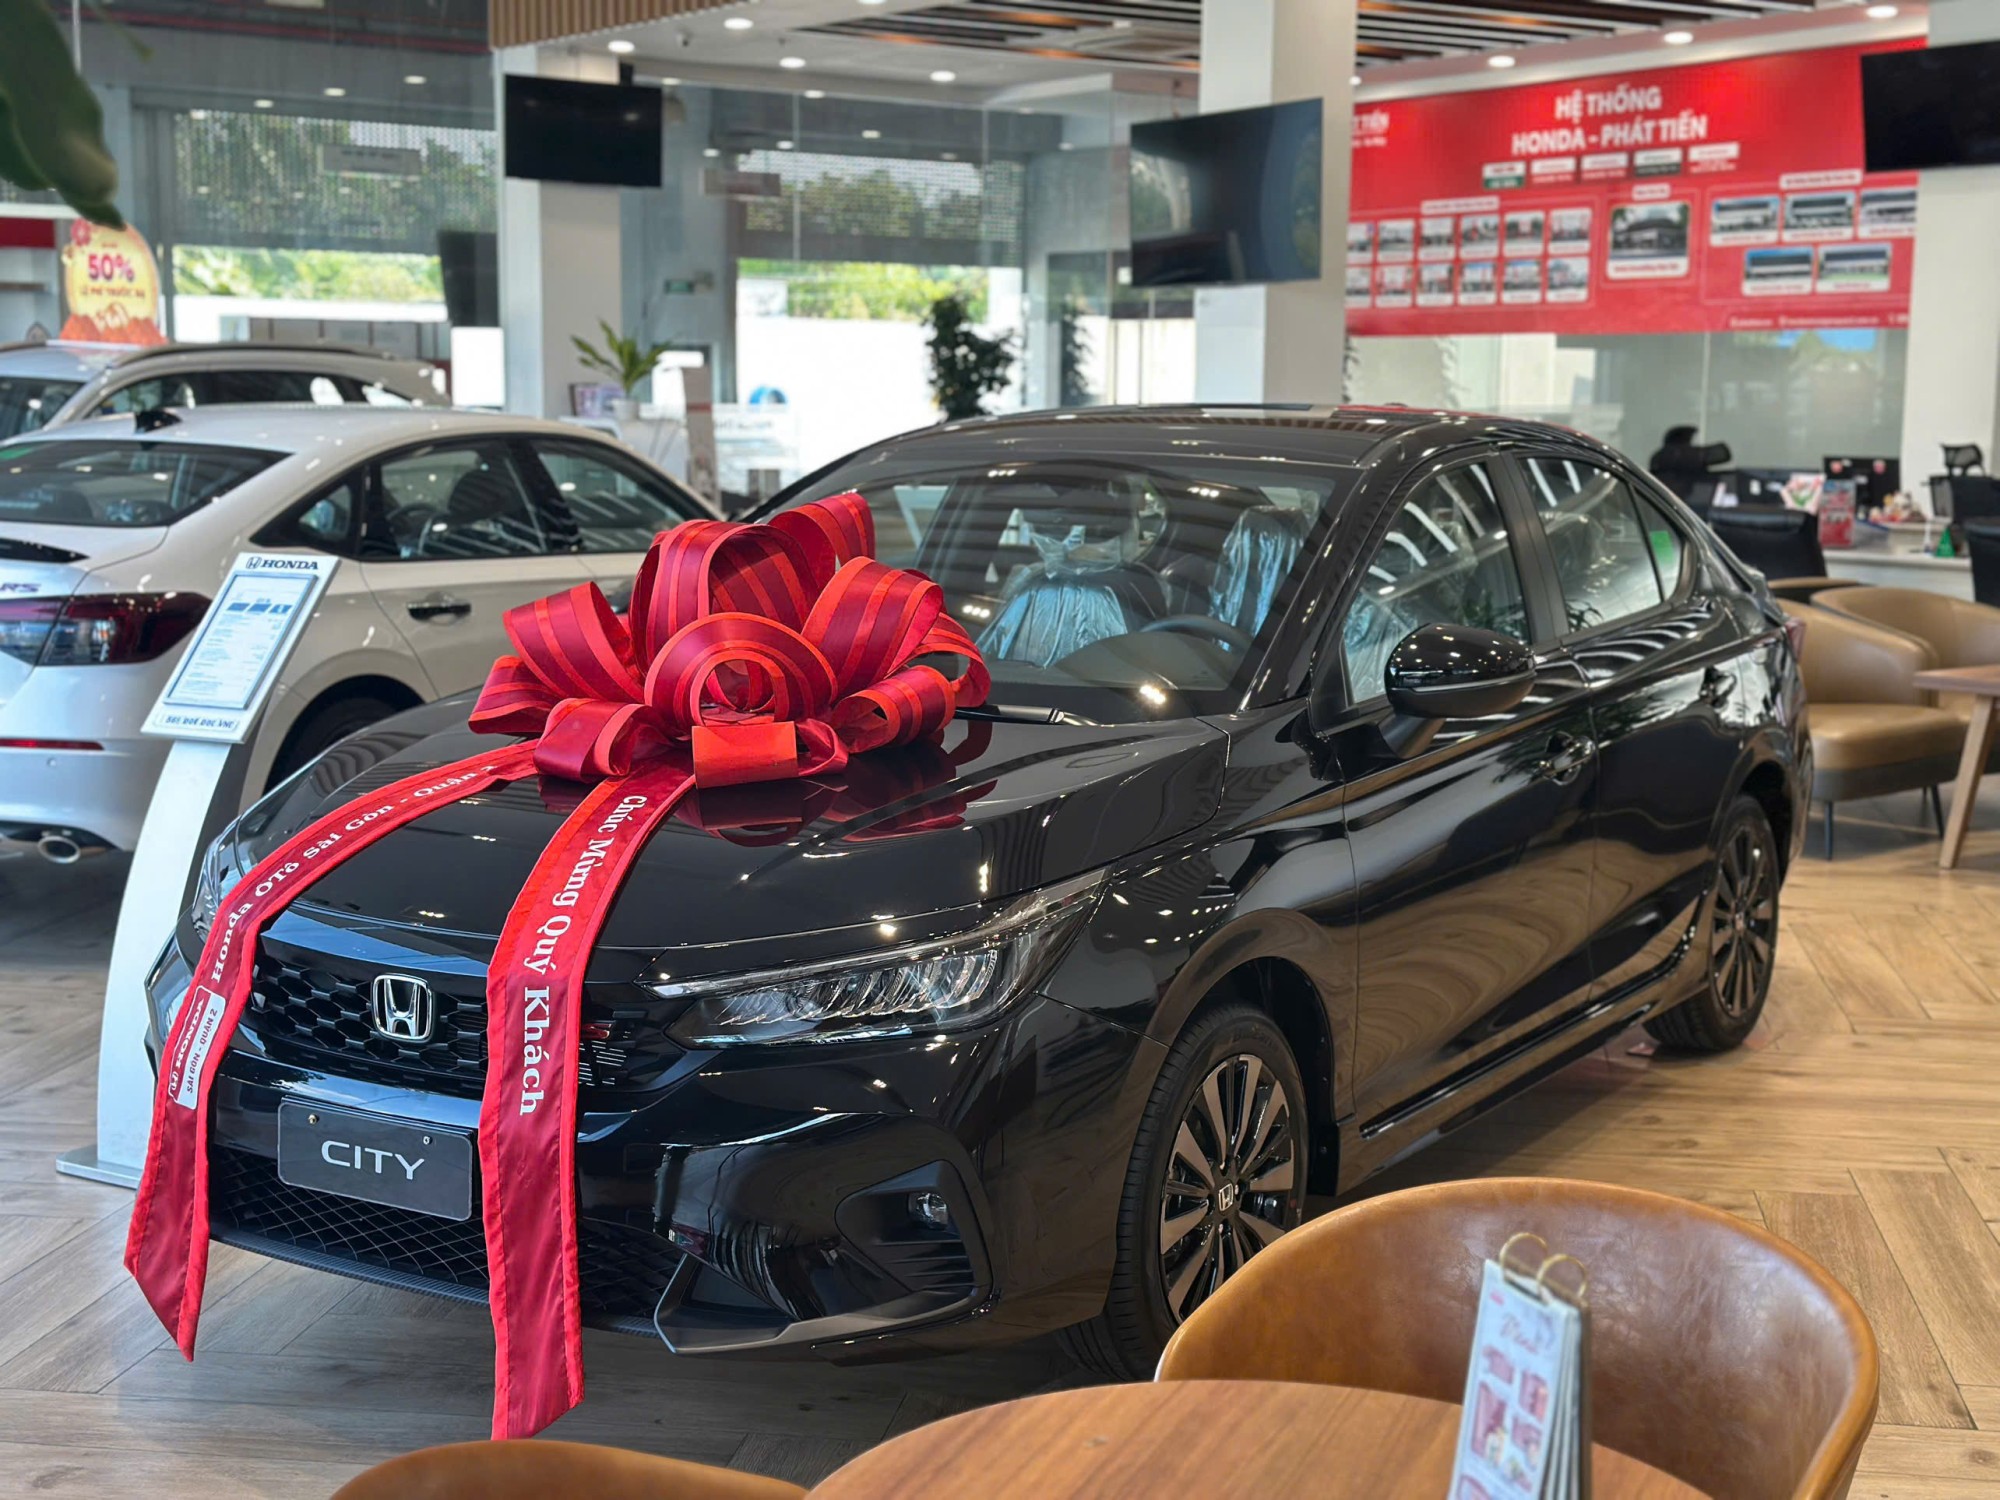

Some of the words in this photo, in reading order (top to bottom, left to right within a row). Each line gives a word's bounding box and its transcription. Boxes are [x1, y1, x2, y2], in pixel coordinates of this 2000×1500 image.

[1511, 127, 1586, 155] HONDA
[1601, 115, 1653, 147] PHÁT
[88, 253, 134, 282] 50%
[261, 559, 318, 570] HONDA
[597, 795, 648, 833] Chúc
[211, 902, 253, 983] Honda
[346, 803, 394, 831] Gòn
[524, 915, 571, 976] Quý
[210, 1008, 218, 1016] 2
[175, 998, 204, 1068] HONDA
[519, 986, 550, 1116] Khách
[321, 1140, 425, 1180] CITY
